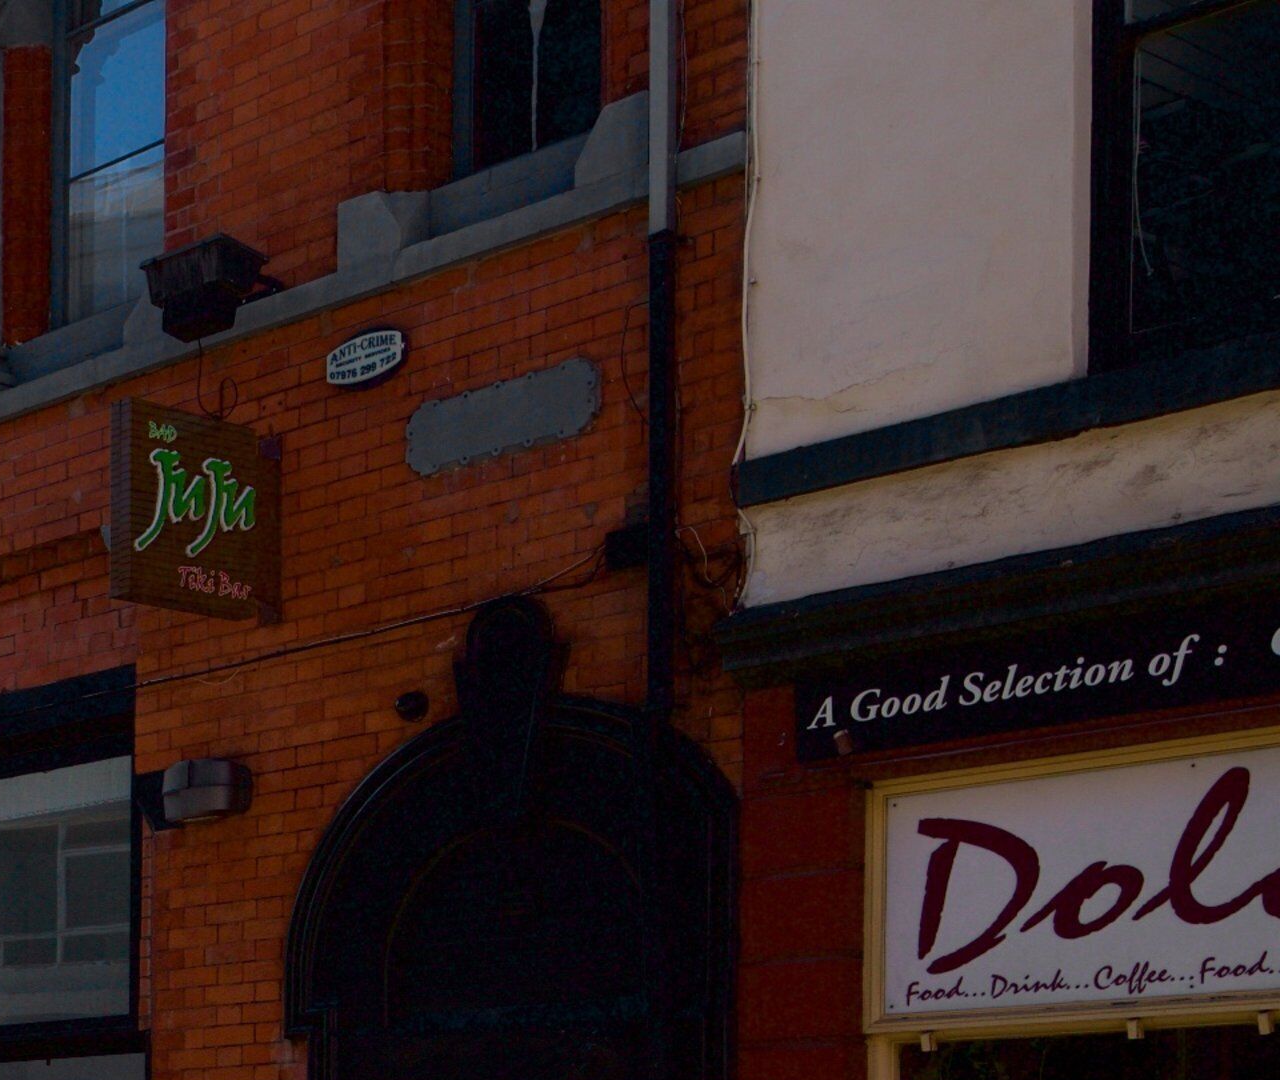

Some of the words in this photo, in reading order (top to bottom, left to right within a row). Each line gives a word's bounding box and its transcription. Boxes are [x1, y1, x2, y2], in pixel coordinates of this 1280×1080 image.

[330, 334, 397, 365] ANTI-CRIME
[148, 420, 178, 444] BAD
[178, 565, 216, 594] Tiki
[218, 570, 253, 600] Bar
[806, 696, 837, 732] A
[849, 675, 950, 723] Good
[958, 656, 1136, 707] Selection
[1148, 634, 1201, 687] of
